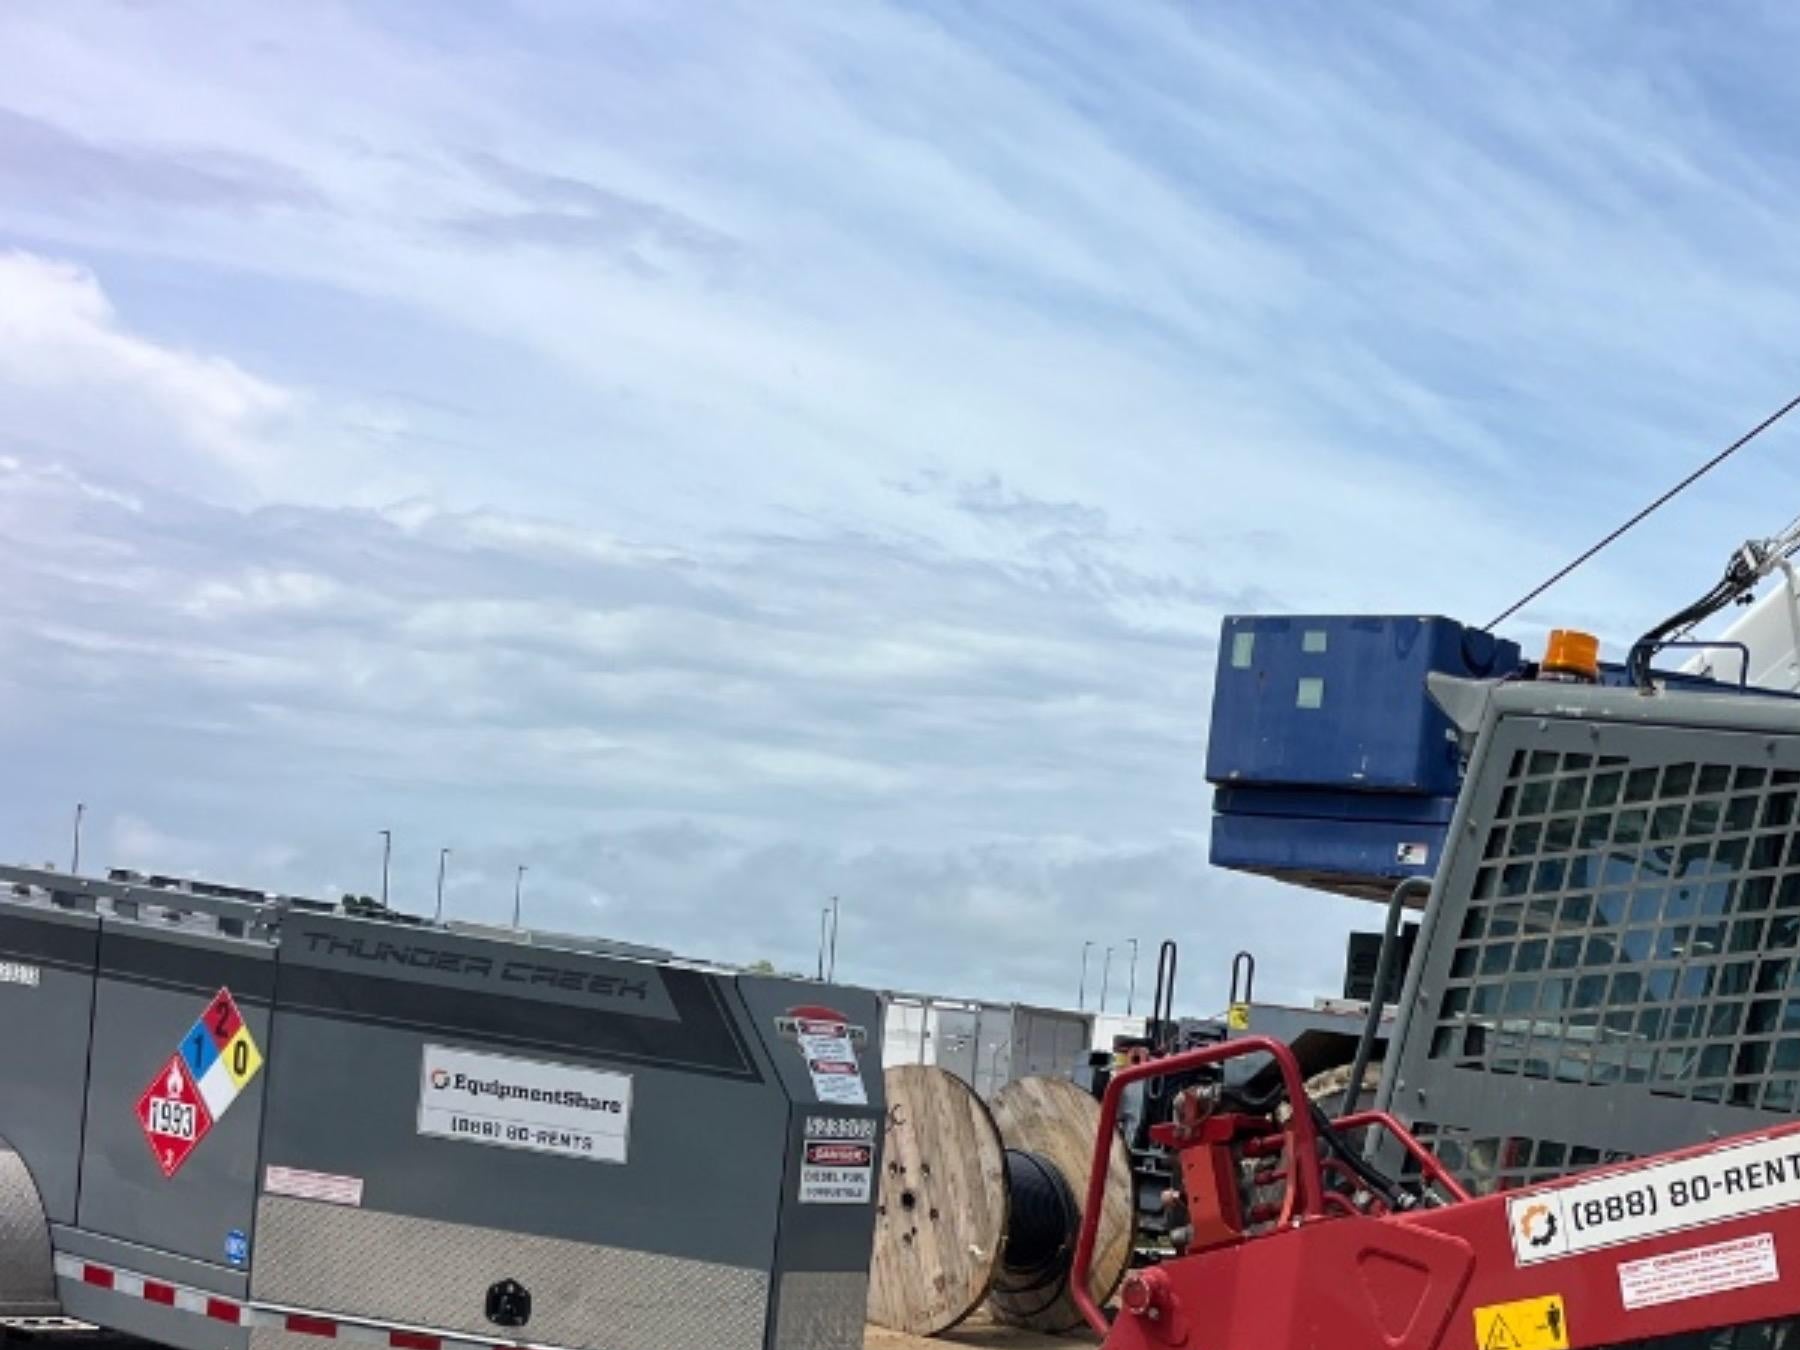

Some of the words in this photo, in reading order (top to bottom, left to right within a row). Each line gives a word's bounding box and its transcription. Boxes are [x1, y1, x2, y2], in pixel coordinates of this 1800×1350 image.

[303, 932, 493, 977] THUNDER
[502, 961, 647, 1001] CREEK
[214, 1001, 229, 1038] 2
[194, 1035, 205, 1065] 1
[233, 1040, 248, 1075] 0
[453, 1073, 622, 1113] EquipmentShare
[151, 1100, 194, 1139] 1993
[1572, 1185, 1656, 1230] (888)
